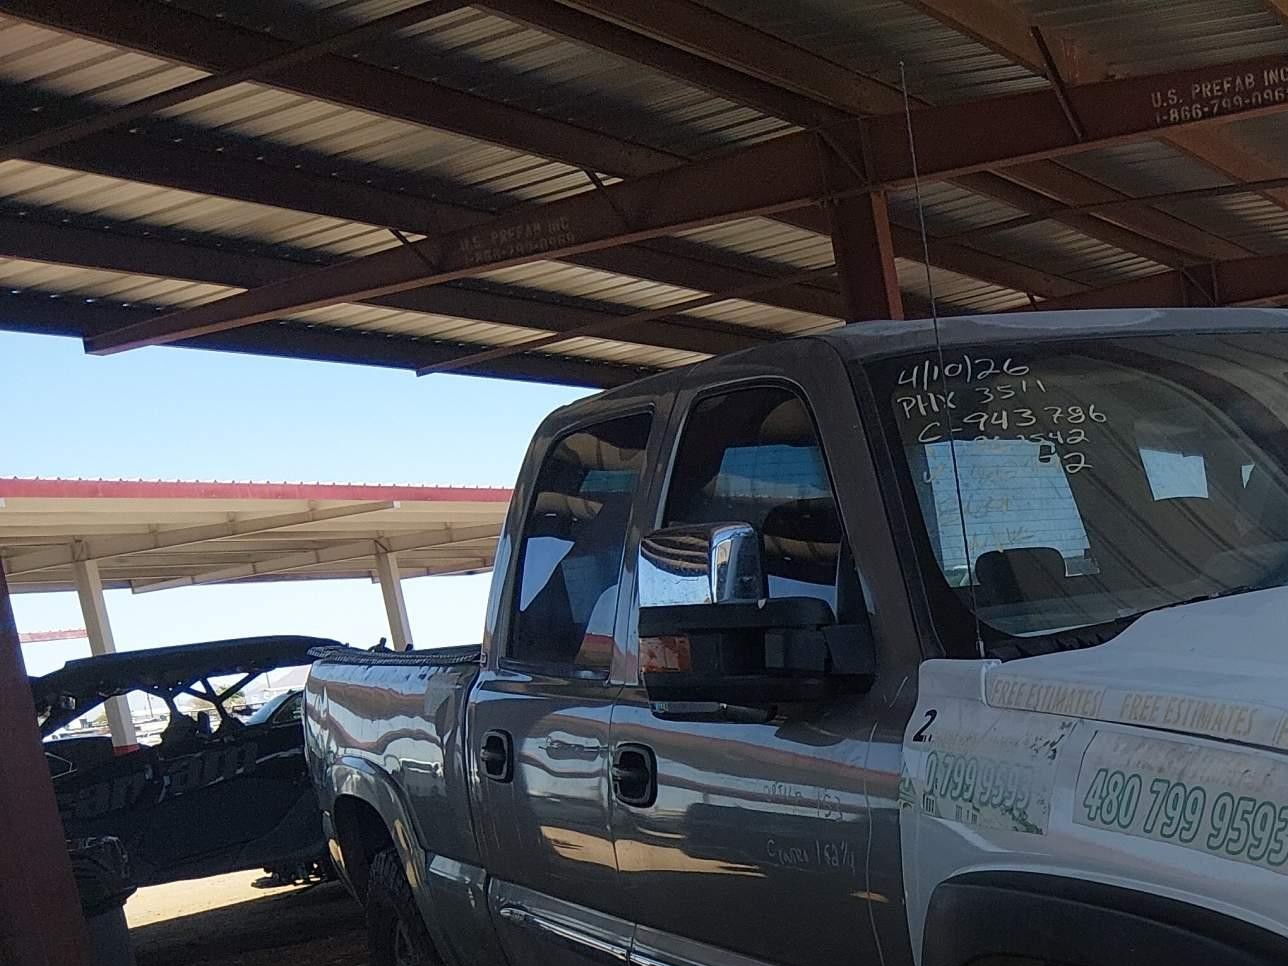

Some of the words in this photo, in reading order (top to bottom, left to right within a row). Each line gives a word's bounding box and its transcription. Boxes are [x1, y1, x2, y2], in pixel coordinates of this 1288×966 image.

[1151, 89, 1184, 109] U.S.
[1191, 73, 1256, 100] PREFAB
[991, 678, 1025, 707] FREE
[1024, 683, 1101, 718] ESTIMATES
[1120, 693, 1165, 722] FREE
[1162, 698, 1259, 736] ESTIMATES
[1083, 768, 1143, 829] 480
[1143, 777, 1207, 844] 799
